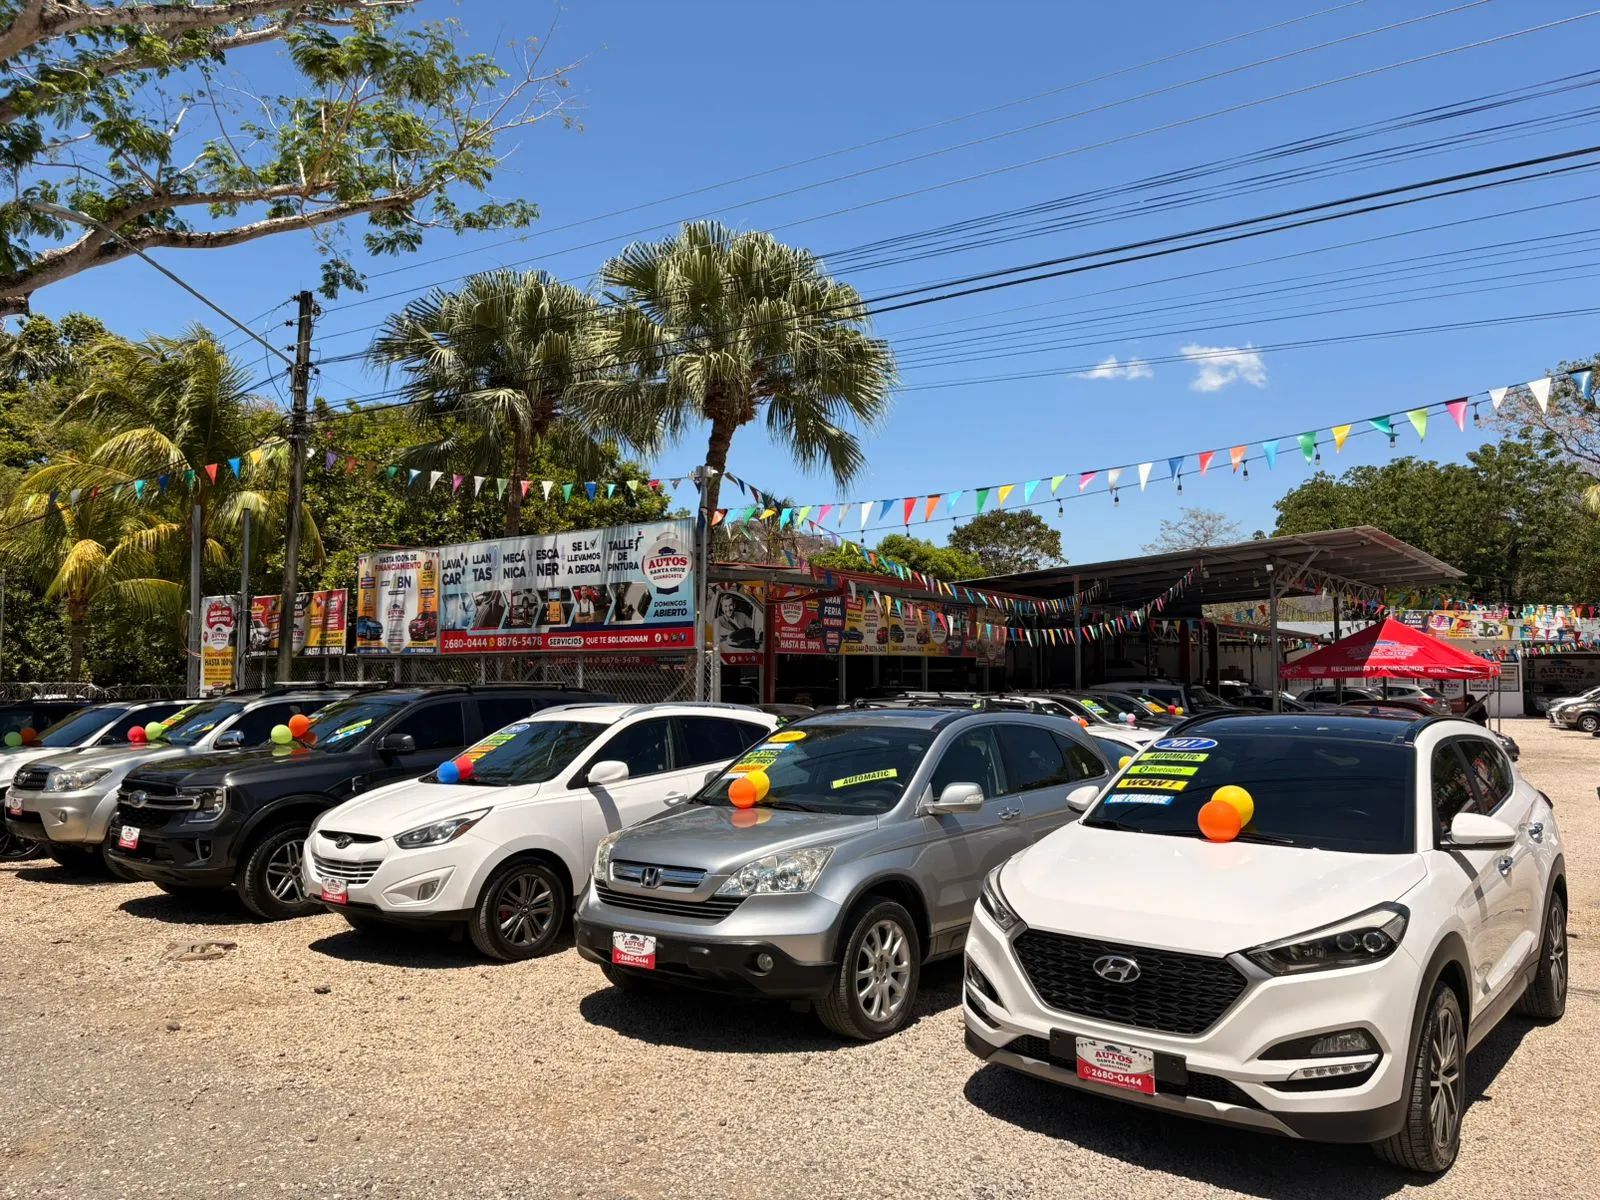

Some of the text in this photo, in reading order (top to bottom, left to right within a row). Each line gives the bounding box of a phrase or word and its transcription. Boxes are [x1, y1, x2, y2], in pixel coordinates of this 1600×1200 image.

[572, 541, 582, 552] SE
[472, 553, 492, 564] LLAN
[536, 548, 559, 560] ESCA
[568, 552, 600, 562] LLEVAMOS
[618, 552, 627, 560] DE
[375, 562, 421, 572] FINANCIAMIENTO
[442, 559, 461, 570] LAVA
[608, 562, 639, 571] PINTURA
[648, 557, 688, 569] AUTOS
[472, 567, 492, 582] TAS
[504, 567, 526, 579] NICA
[536, 562, 559, 576] NER
[568, 564, 600, 574] A DEKRA
[398, 576, 411, 588] BN
[442, 572, 461, 586] CAR
[653, 608, 687, 618] ABIERTO
[824, 606, 841, 615] FERIA
[444, 637, 542, 648] 2680-0444 8876-5478
[550, 638, 582, 646] SERVICIOS
[607, 635, 648, 644] SOLUCIONAN
[781, 640, 798, 649] HASTA
[807, 641, 820, 649] 100%
[1170, 739, 1206, 747] 2017
[843, 770, 890, 784] AUTOMATIC
[620, 954, 649, 964] 2680-0444
[1095, 1051, 1133, 1064] AUTOS
[1091, 1069, 1142, 1086] 2680-0444
